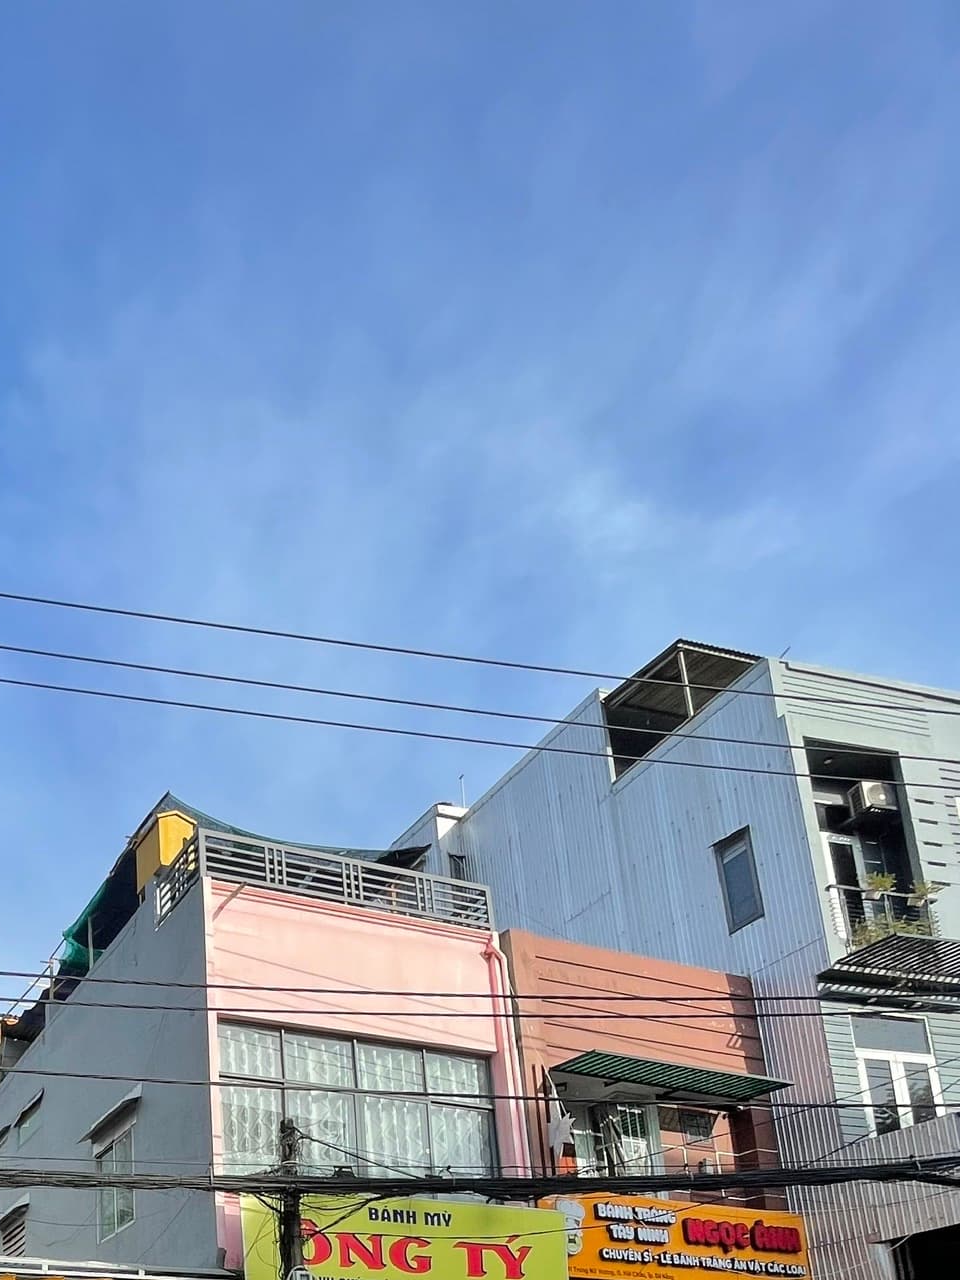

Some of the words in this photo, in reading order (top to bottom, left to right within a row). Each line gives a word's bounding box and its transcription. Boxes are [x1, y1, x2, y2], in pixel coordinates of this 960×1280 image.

[369, 1206, 416, 1224] BÁNH
[595, 1202, 634, 1221] BÁNH
[637, 1226, 669, 1243] NINH
[453, 1234, 533, 1280] TÝ
[602, 1247, 642, 1262] CHUYÊN
[673, 1253, 700, 1267] BÁNH
[701, 1256, 732, 1271] TRÁNG
[767, 1260, 786, 1274] CÁC
